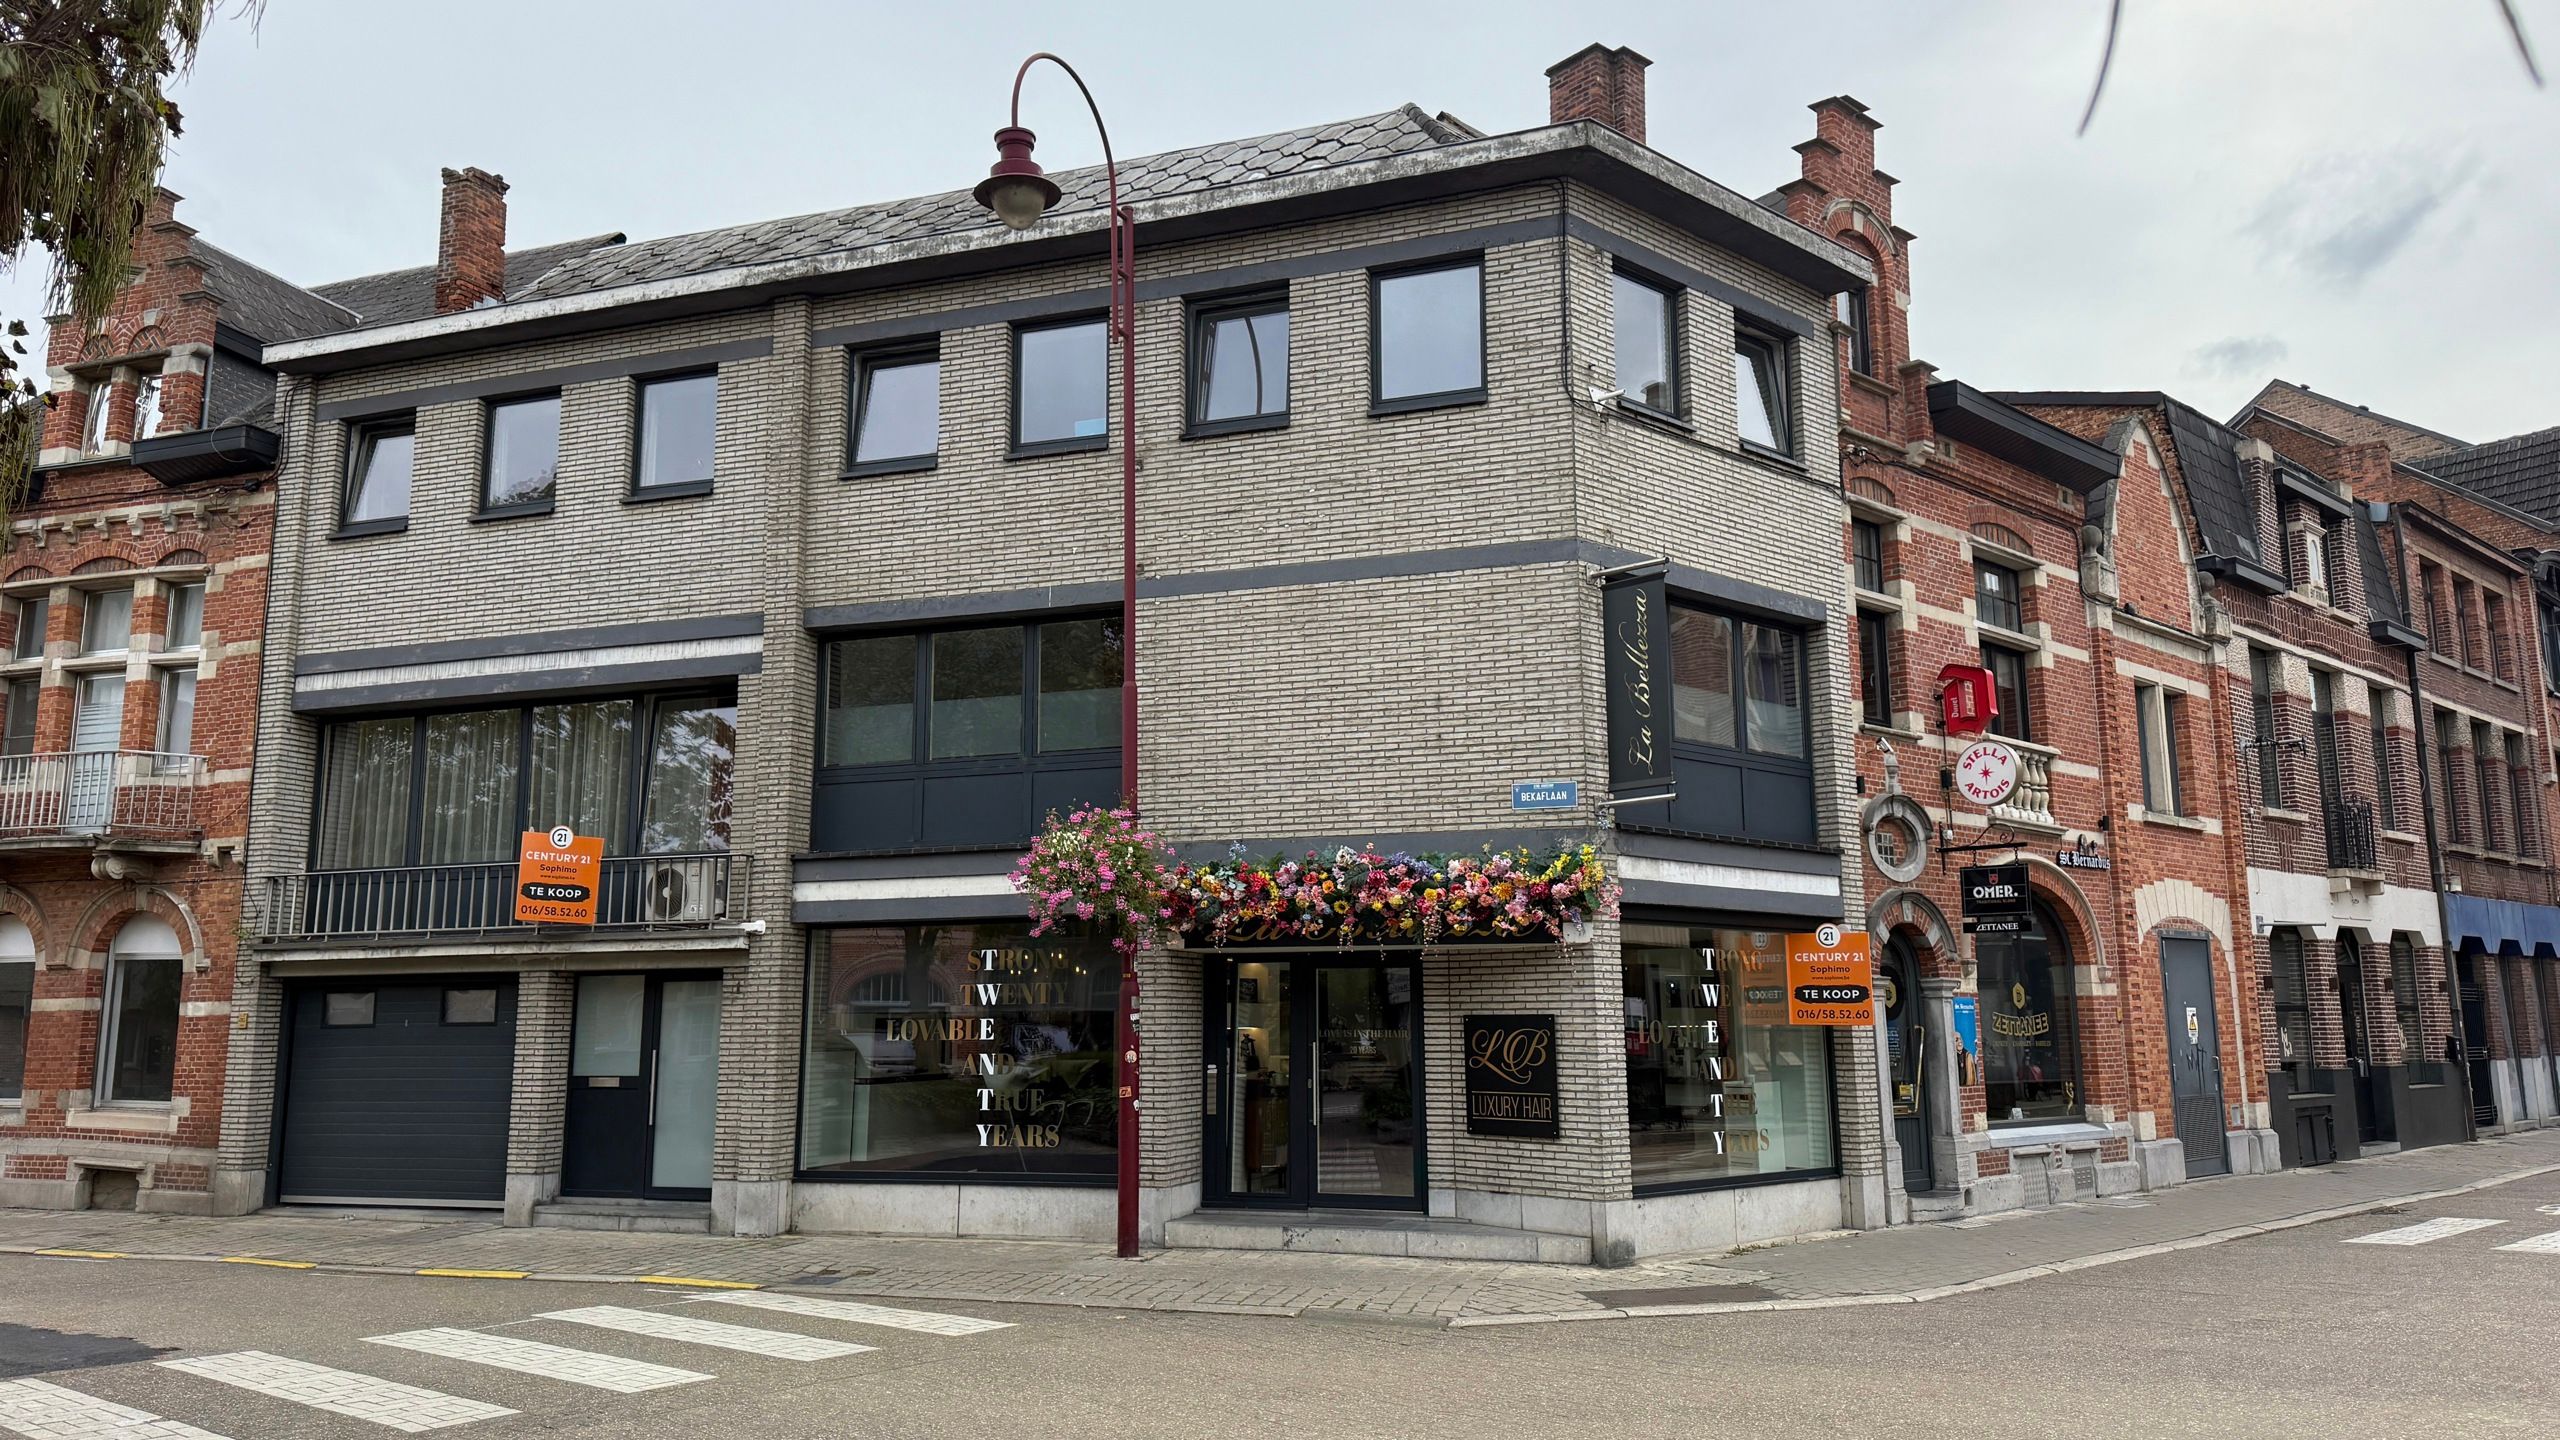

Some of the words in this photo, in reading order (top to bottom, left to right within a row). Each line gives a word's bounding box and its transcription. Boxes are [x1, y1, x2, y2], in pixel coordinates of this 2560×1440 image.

[1618, 588, 1651, 718] Bellezza
[1950, 697, 1959, 718] Duvel
[1628, 724, 1653, 775] La
[1962, 747, 2008, 770] STELLA
[1521, 790, 1567, 801] BEKAFLAAN
[1964, 779, 2010, 800] ARTOIS
[526, 851, 578, 863] CENTURY
[580, 855, 591, 864] 21
[2060, 850, 2072, 865] St.
[540, 864, 577, 874] Sophimo
[529, 886, 544, 896] TE
[547, 888, 582, 898] KOOP
[1973, 885, 2018, 899] OMER.
[521, 904, 587, 918] 016/58.52.60
[1976, 922, 2019, 931] ZETTANEE
[967, 949, 1070, 971] STRONG
[1795, 952, 1850, 962] CENTURY
[1852, 952, 1864, 962] 21
[1810, 965, 1850, 974] Sophimo
[960, 982, 1070, 1006] TWENTY
[1803, 990, 1819, 999] TE
[1823, 990, 1860, 999] KOOP
[1797, 1009, 1870, 1019] 016/58.52.60
[1992, 1011, 2049, 1036] ZETTANEE
[885, 1018, 995, 1041] LOVABLE
[962, 1052, 1015, 1076] AND
[976, 1088, 1045, 1111] TRUE
[1472, 1095, 1520, 1117] LUXURY
[1522, 1097, 1552, 1119] HAIR
[975, 1124, 1060, 1148] YEARS
